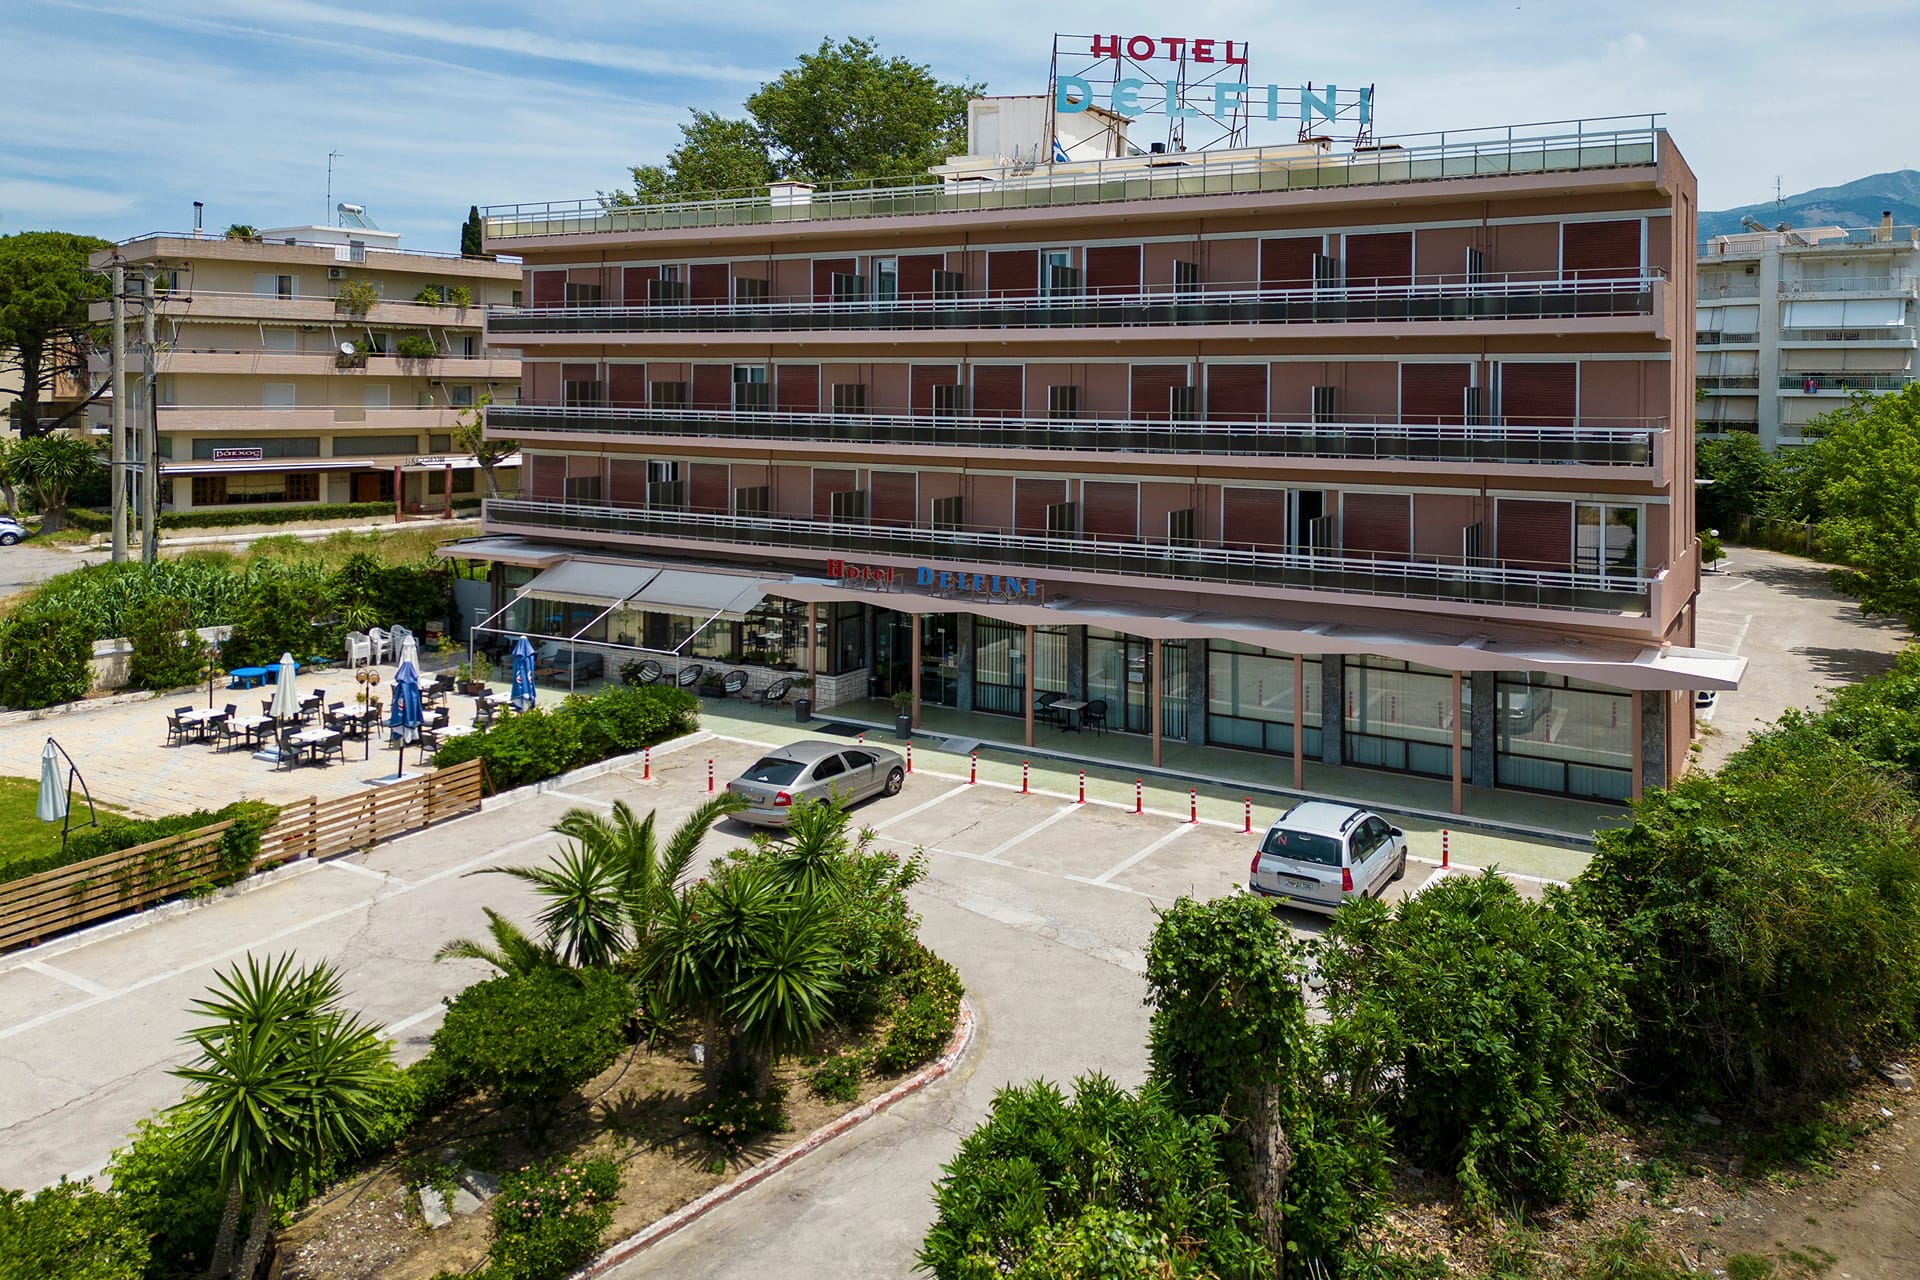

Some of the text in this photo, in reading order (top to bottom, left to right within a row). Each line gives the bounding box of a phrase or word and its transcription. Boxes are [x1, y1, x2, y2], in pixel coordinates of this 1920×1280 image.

[1090, 34, 1248, 65] HOTEL
[1057, 75, 1371, 124] DELFINI
[827, 559, 1038, 596] Hotel DELFINI
